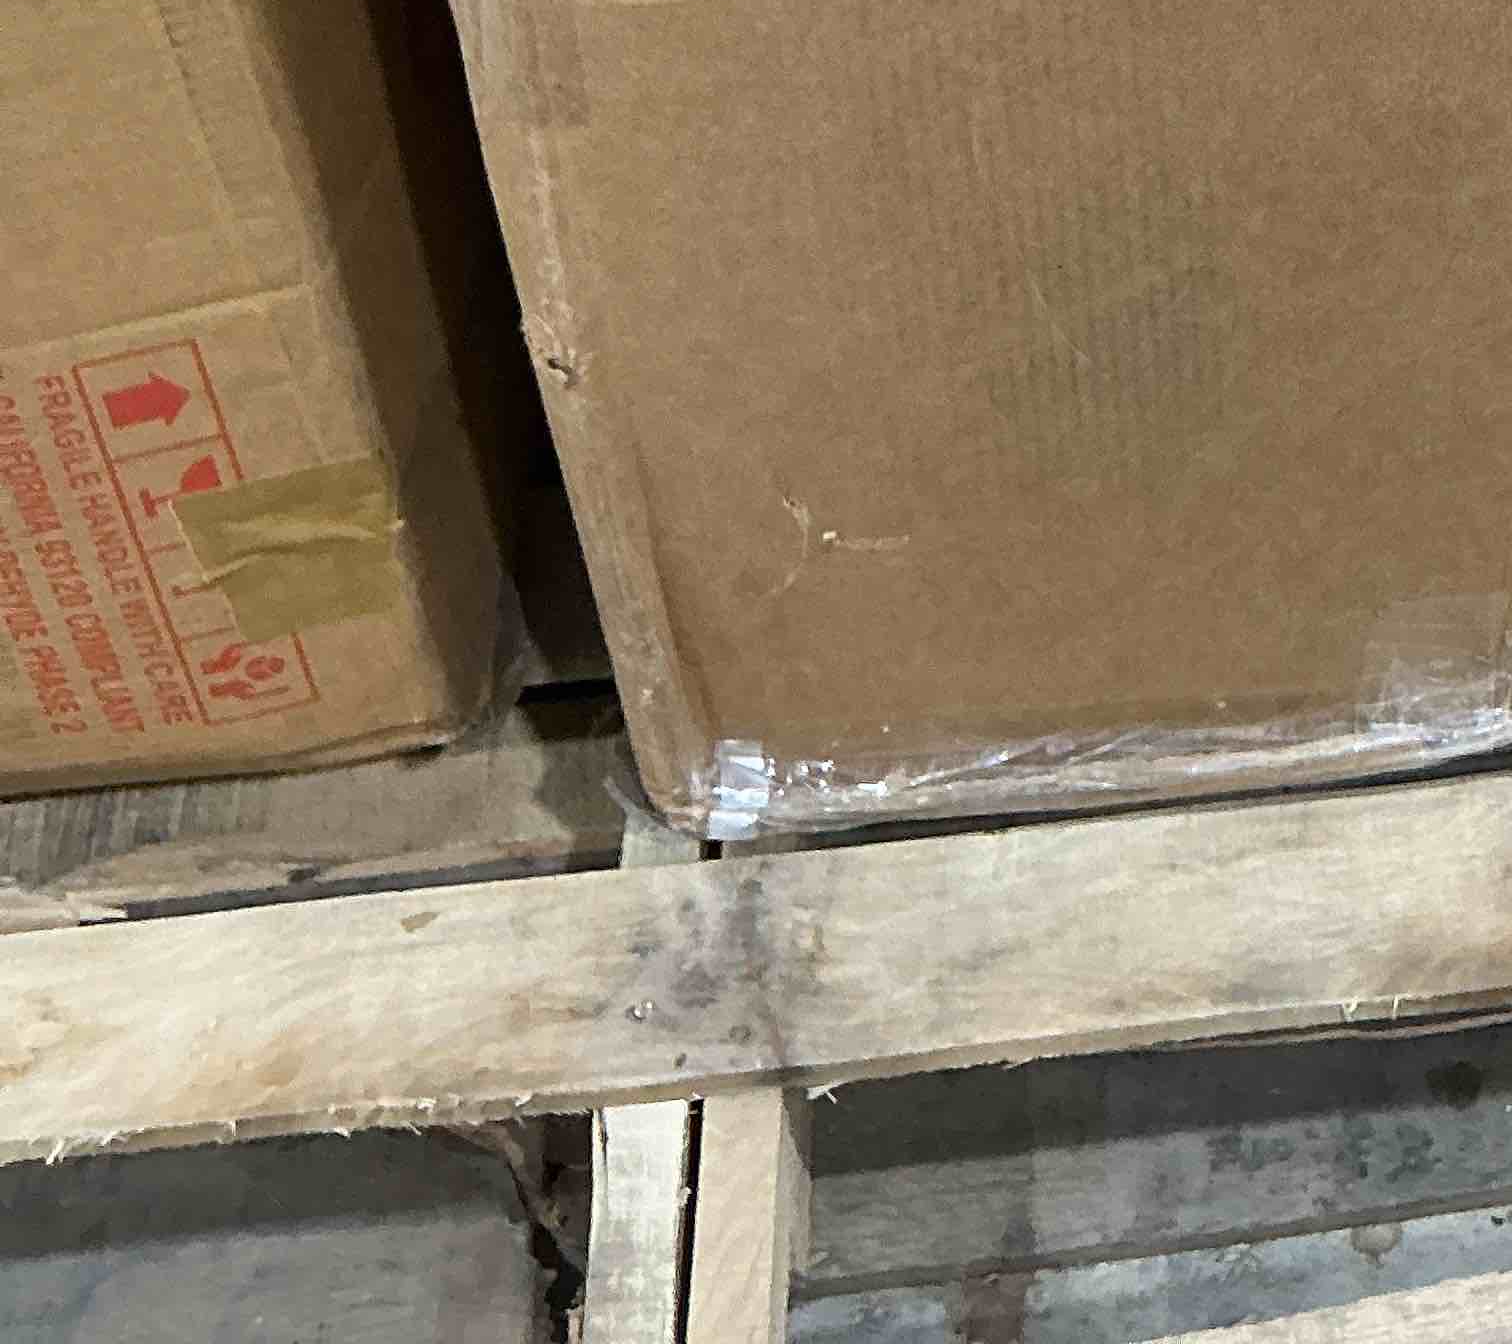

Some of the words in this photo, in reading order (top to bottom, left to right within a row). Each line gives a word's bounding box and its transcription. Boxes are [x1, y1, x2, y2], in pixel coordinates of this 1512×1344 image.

[34, 374, 100, 491] FRAGILE
[81, 487, 141, 596] HANDLE
[120, 597, 163, 659] WITH
[142, 661, 194, 726] CARE
[51, 718, 89, 735] 2
[65, 613, 145, 733] COMPLIANT
